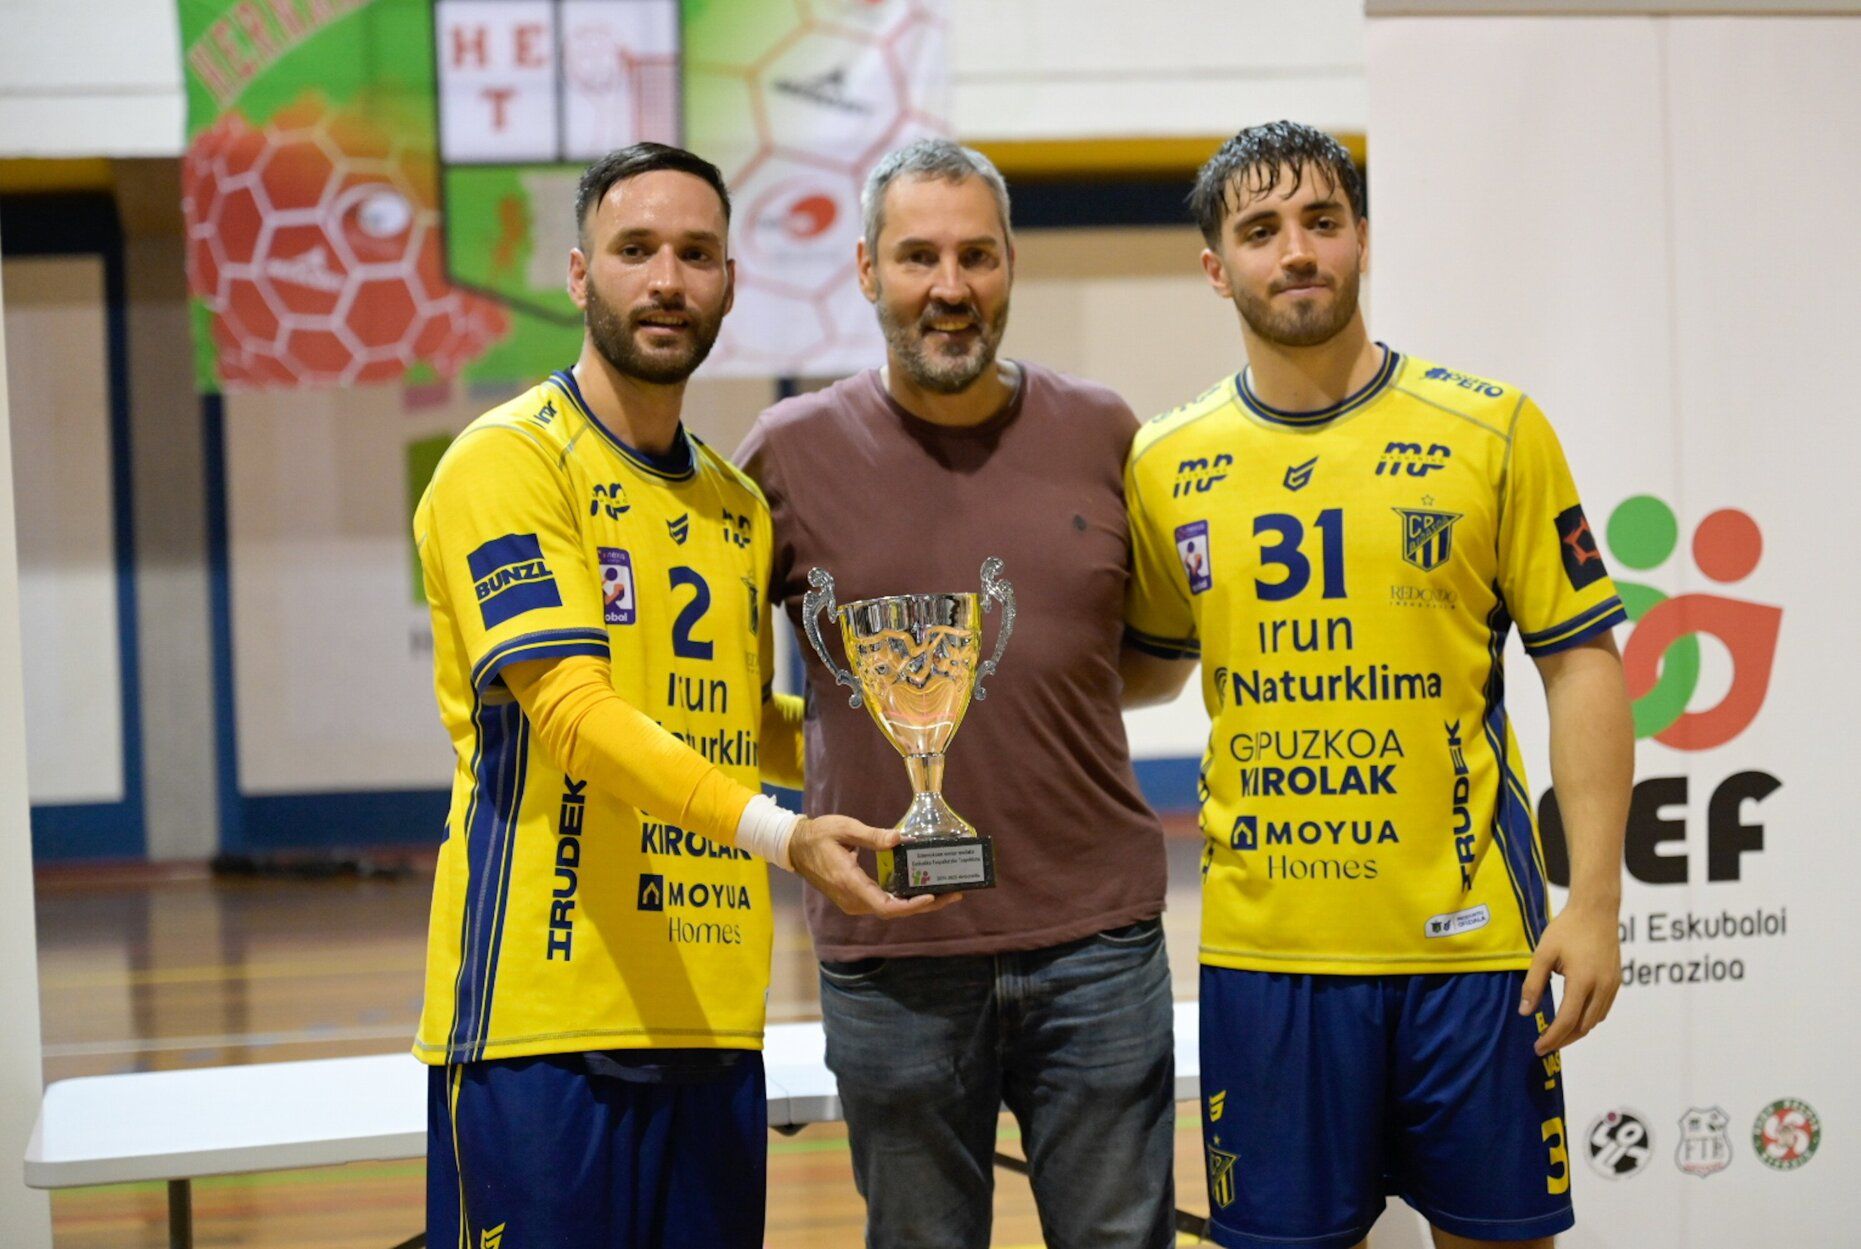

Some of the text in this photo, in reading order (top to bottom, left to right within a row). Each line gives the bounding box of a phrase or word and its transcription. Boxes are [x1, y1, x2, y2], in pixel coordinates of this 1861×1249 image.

[1253, 508, 1347, 601] 31
[475, 561, 553, 601] BUNZL
[605, 611, 628, 622] obal
[669, 566, 713, 659] 2
[1231, 664, 1442, 706] Naturklima
[1241, 764, 1398, 797] KIROLAK
[1444, 718, 1476, 893] IRUDEK
[1265, 821, 1399, 845] MOYUA
[547, 773, 587, 961] IRUDEK
[1268, 855, 1378, 880] Homes
[669, 881, 751, 910] MOYUA
[669, 917, 741, 945] Homes
[1648, 907, 1787, 943] Eskubaloi
[1621, 954, 1744, 985] derazioa
